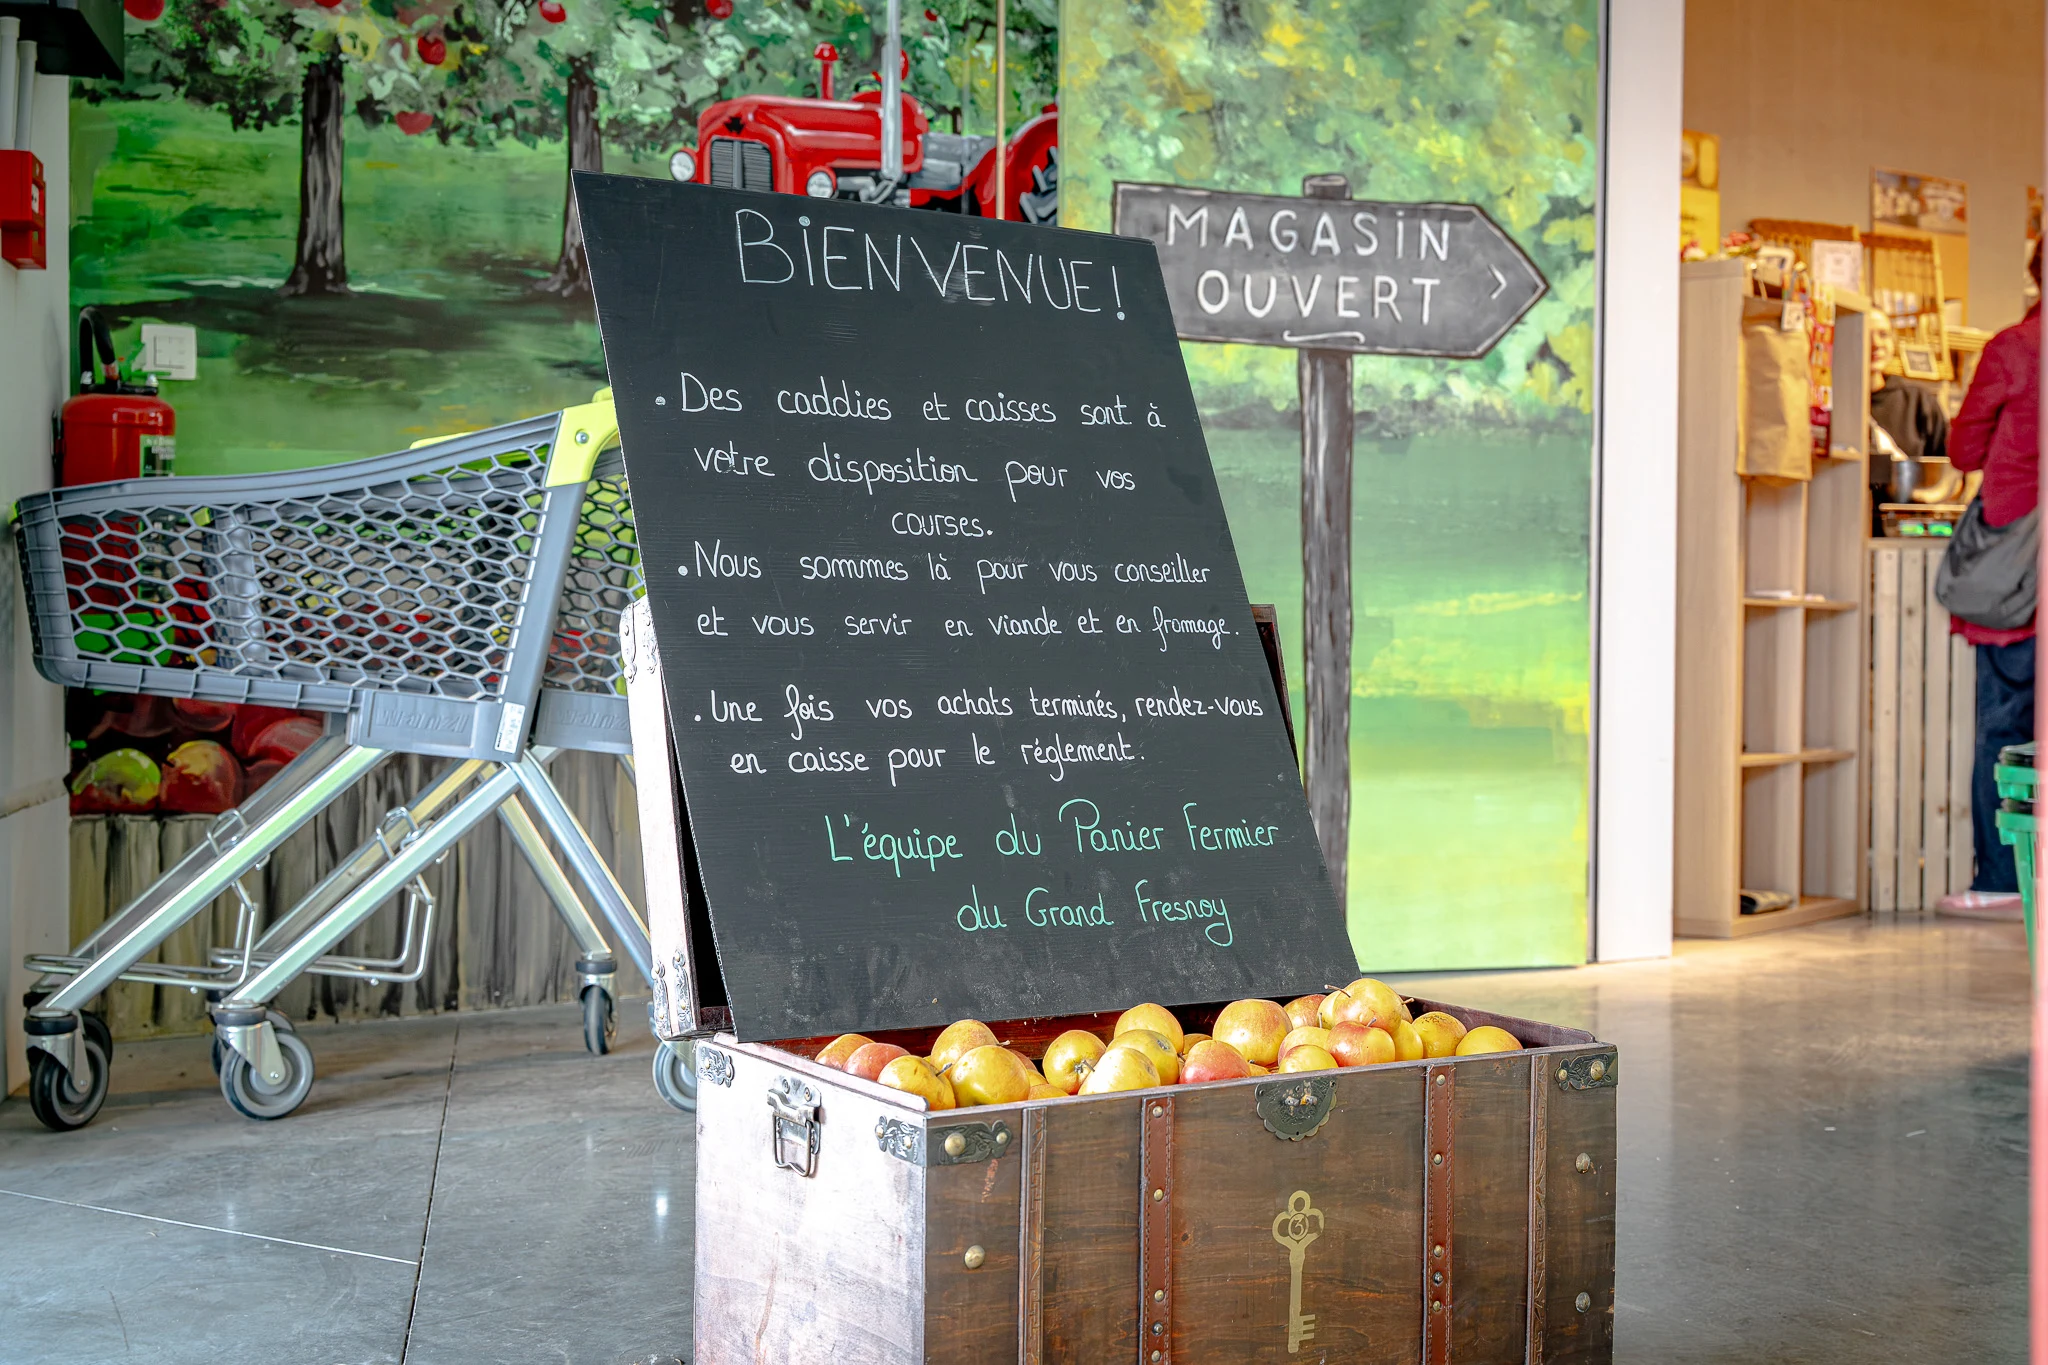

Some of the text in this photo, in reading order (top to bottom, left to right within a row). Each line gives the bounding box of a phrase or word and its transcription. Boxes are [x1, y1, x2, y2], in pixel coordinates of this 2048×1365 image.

[1197, 269, 1441, 326] OUVERT
[680, 371, 1167, 428] Des caddies et caisses sont à
[693, 440, 1136, 503] votre disposition pour vos
[891, 511, 994, 538] courses.
[694, 538, 1211, 595] Nous sommes là pour vous conseiller
[697, 605, 1241, 653] et vous servir en viande et en fromage.
[783, 683, 835, 741] fois
[865, 698, 913, 719] vos
[937, 686, 1014, 716] achats
[1029, 686, 1127, 723] terminés,
[1134, 689, 1264, 718] rendez-vous
[729, 753, 768, 775] en
[787, 751, 870, 774] caisse
[887, 747, 947, 788] pour
[971, 732, 996, 765] le
[995, 812, 1042, 856] du
[1058, 798, 1164, 853] Panier
[1182, 802, 1279, 851] Fermier
[956, 878, 1233, 947] du Grand Fresnoy
